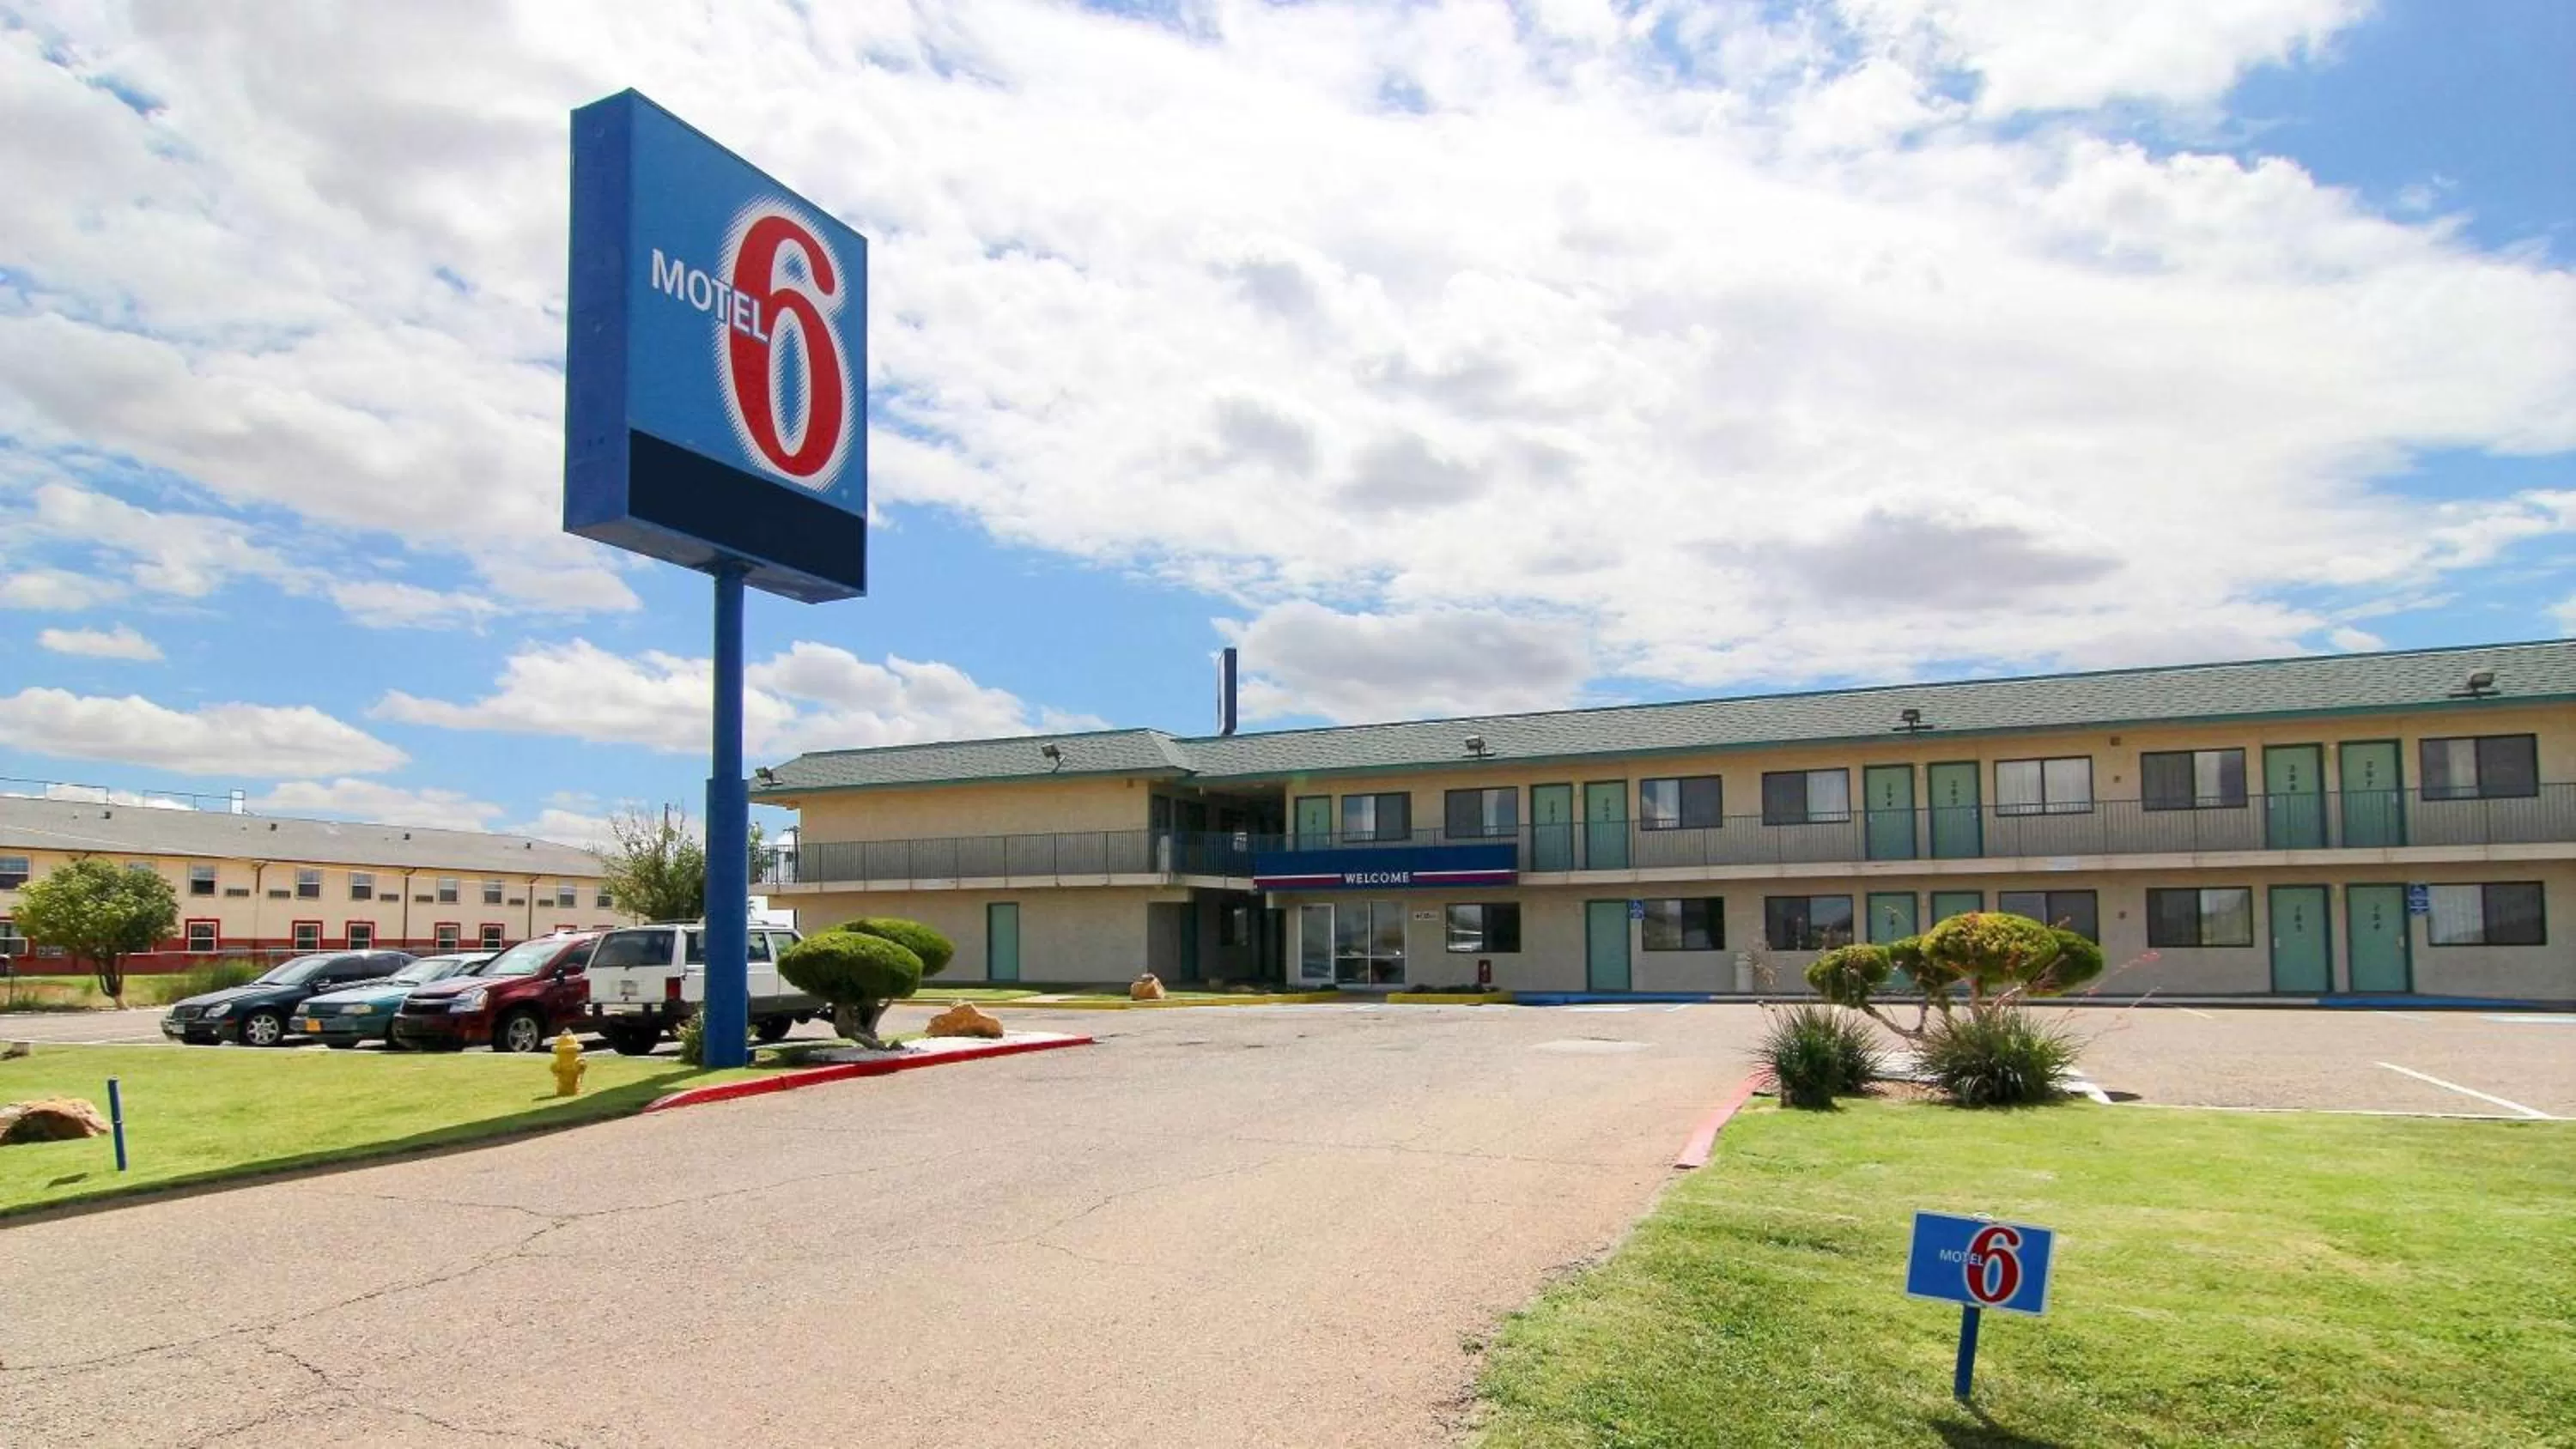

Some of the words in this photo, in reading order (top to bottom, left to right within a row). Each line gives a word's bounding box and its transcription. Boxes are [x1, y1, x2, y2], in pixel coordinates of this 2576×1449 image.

[651, 247, 771, 344] MOTEL
[728, 214, 844, 478] 6
[1344, 871, 1410, 884] WELCOME
[1939, 1248, 1984, 1267] MOTEL
[1966, 1225, 2020, 1305] 6
